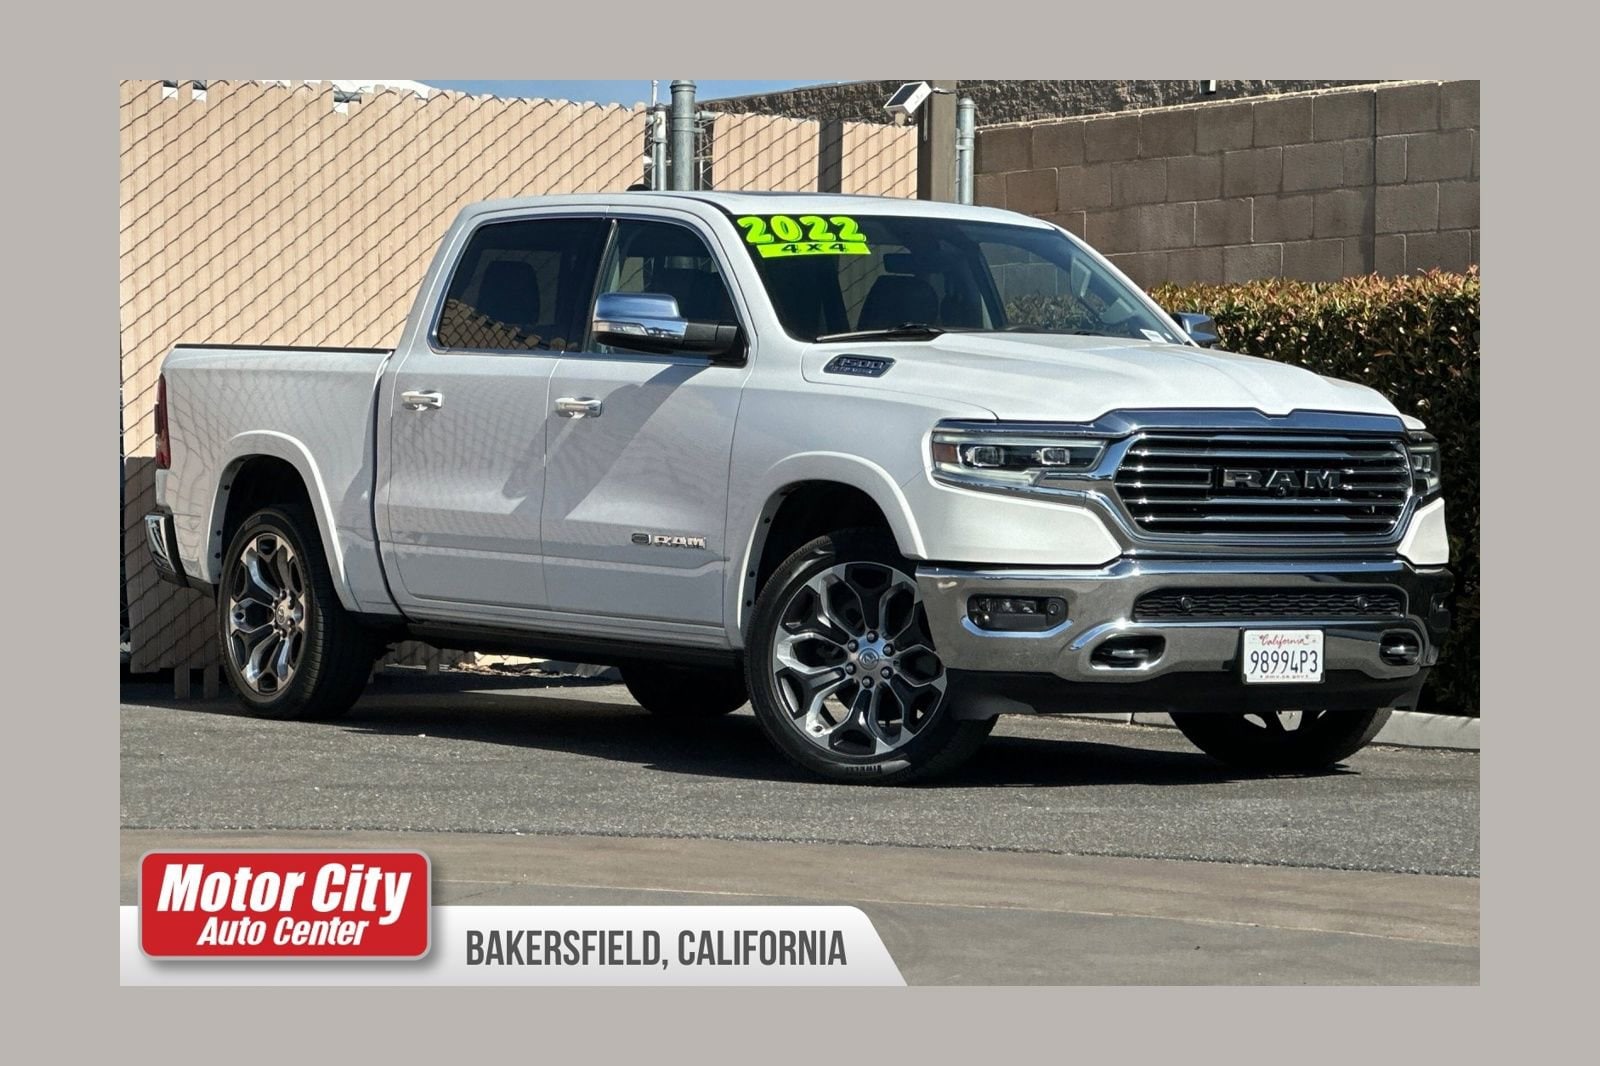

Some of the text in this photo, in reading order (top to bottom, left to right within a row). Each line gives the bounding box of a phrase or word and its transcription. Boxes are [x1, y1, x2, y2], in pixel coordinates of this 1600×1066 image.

[737, 215, 866, 243] 2022
[839, 358, 884, 369] 1500
[1223, 469, 1341, 489] RAM
[654, 535, 706, 549] RAM
[1259, 634, 1310, 649] California
[1250, 650, 1318, 674] 98994P3
